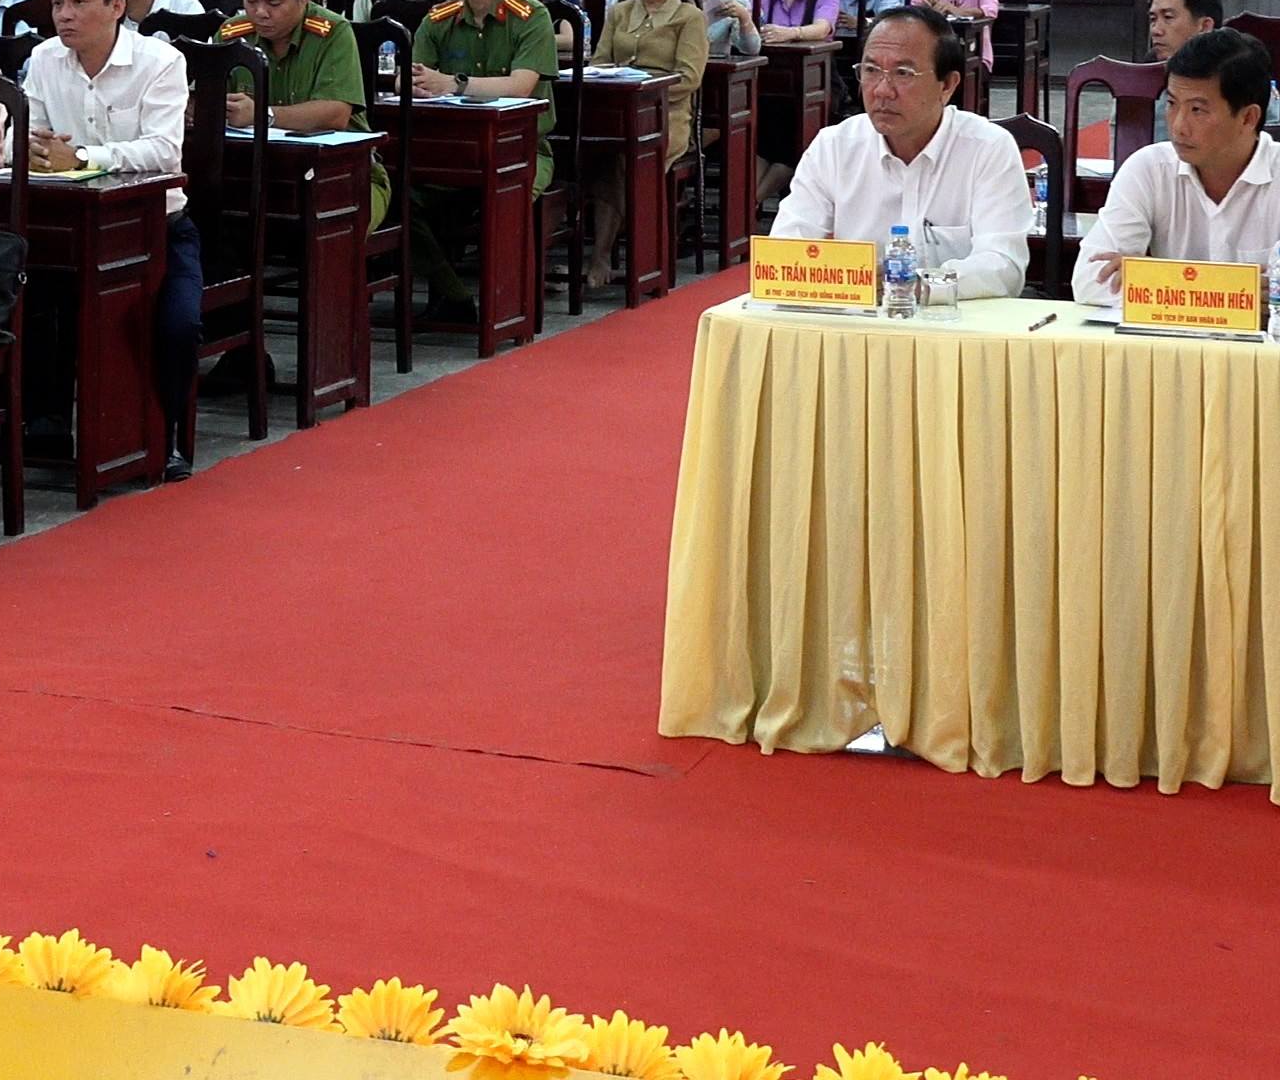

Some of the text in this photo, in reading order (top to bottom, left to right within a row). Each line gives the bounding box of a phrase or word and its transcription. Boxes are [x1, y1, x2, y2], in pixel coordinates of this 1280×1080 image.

[755, 261, 778, 281] ÔNG:
[781, 262, 807, 282] TRẦN
[810, 264, 843, 285] HOÀNG
[847, 264, 873, 286] TUẤN
[1128, 284, 1153, 304] ÔNG:
[1156, 286, 1186, 309] ĐẶNG
[1189, 290, 1225, 309] THANH
[1228, 288, 1254, 311] HIỀN
